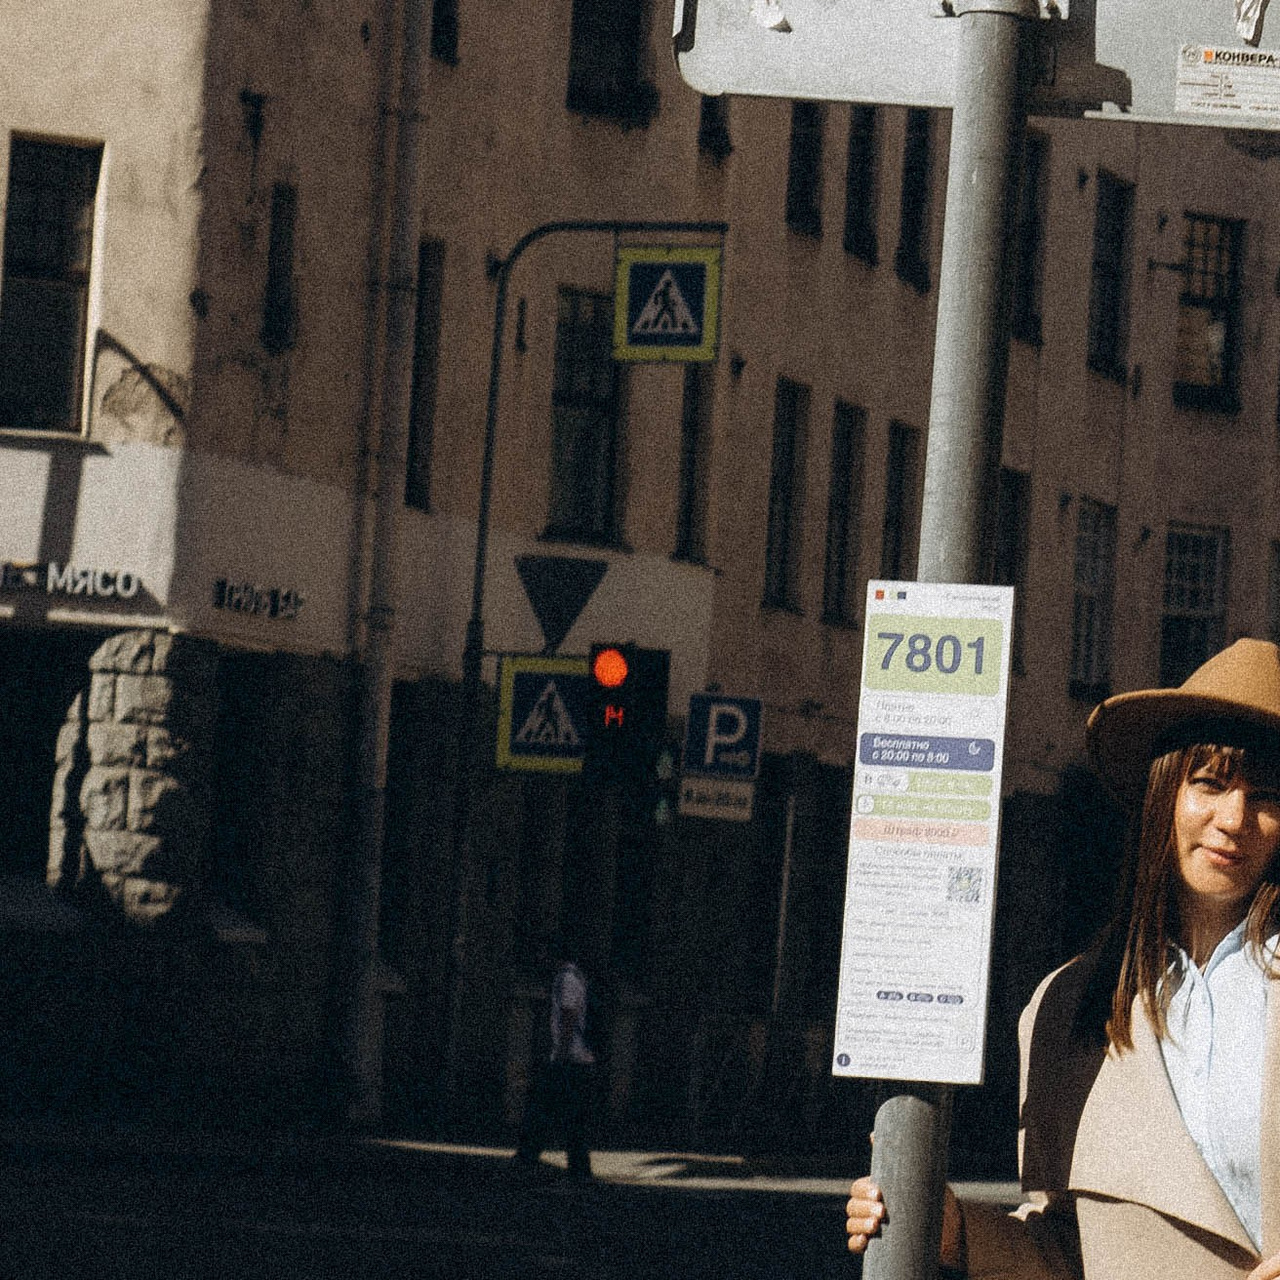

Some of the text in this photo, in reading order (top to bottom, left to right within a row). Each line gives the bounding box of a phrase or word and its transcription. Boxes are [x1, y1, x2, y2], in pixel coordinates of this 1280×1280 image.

[47, 561, 139, 599] МЯСО
[877, 632, 985, 675] 7801
[705, 703, 748, 764] P
[873, 737, 929, 750] Бесплатно
